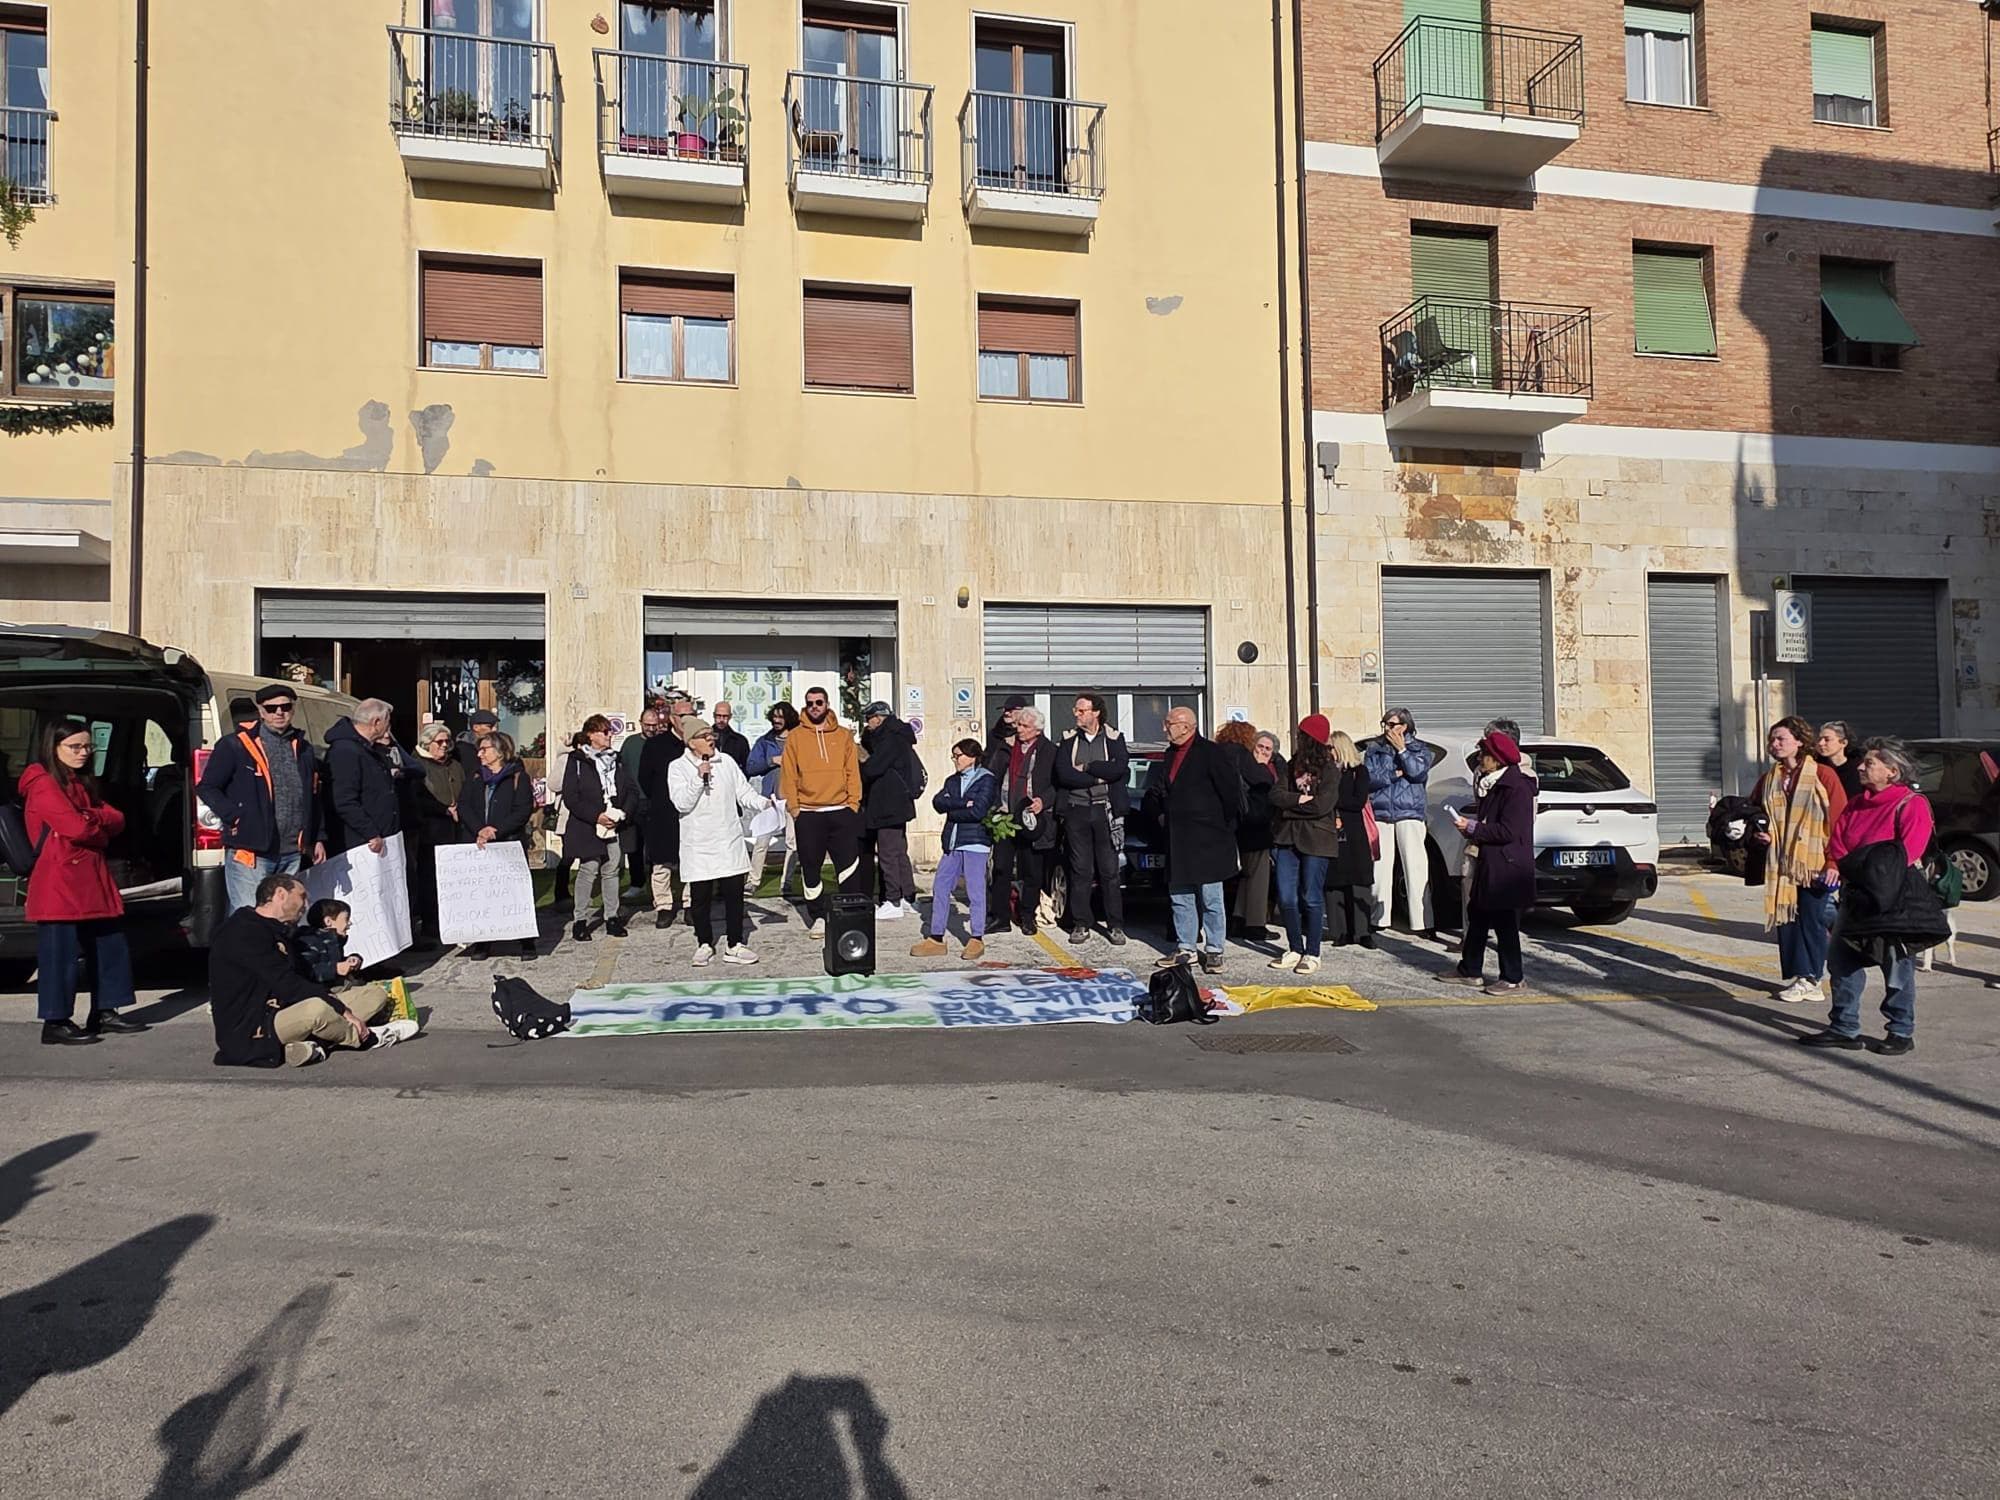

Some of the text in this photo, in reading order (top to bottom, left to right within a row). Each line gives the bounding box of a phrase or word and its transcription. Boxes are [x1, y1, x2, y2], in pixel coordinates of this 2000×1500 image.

[1562, 852, 1575, 864] GW
[668, 975, 929, 996] VERDE
[660, 994, 898, 1021] AUTO
